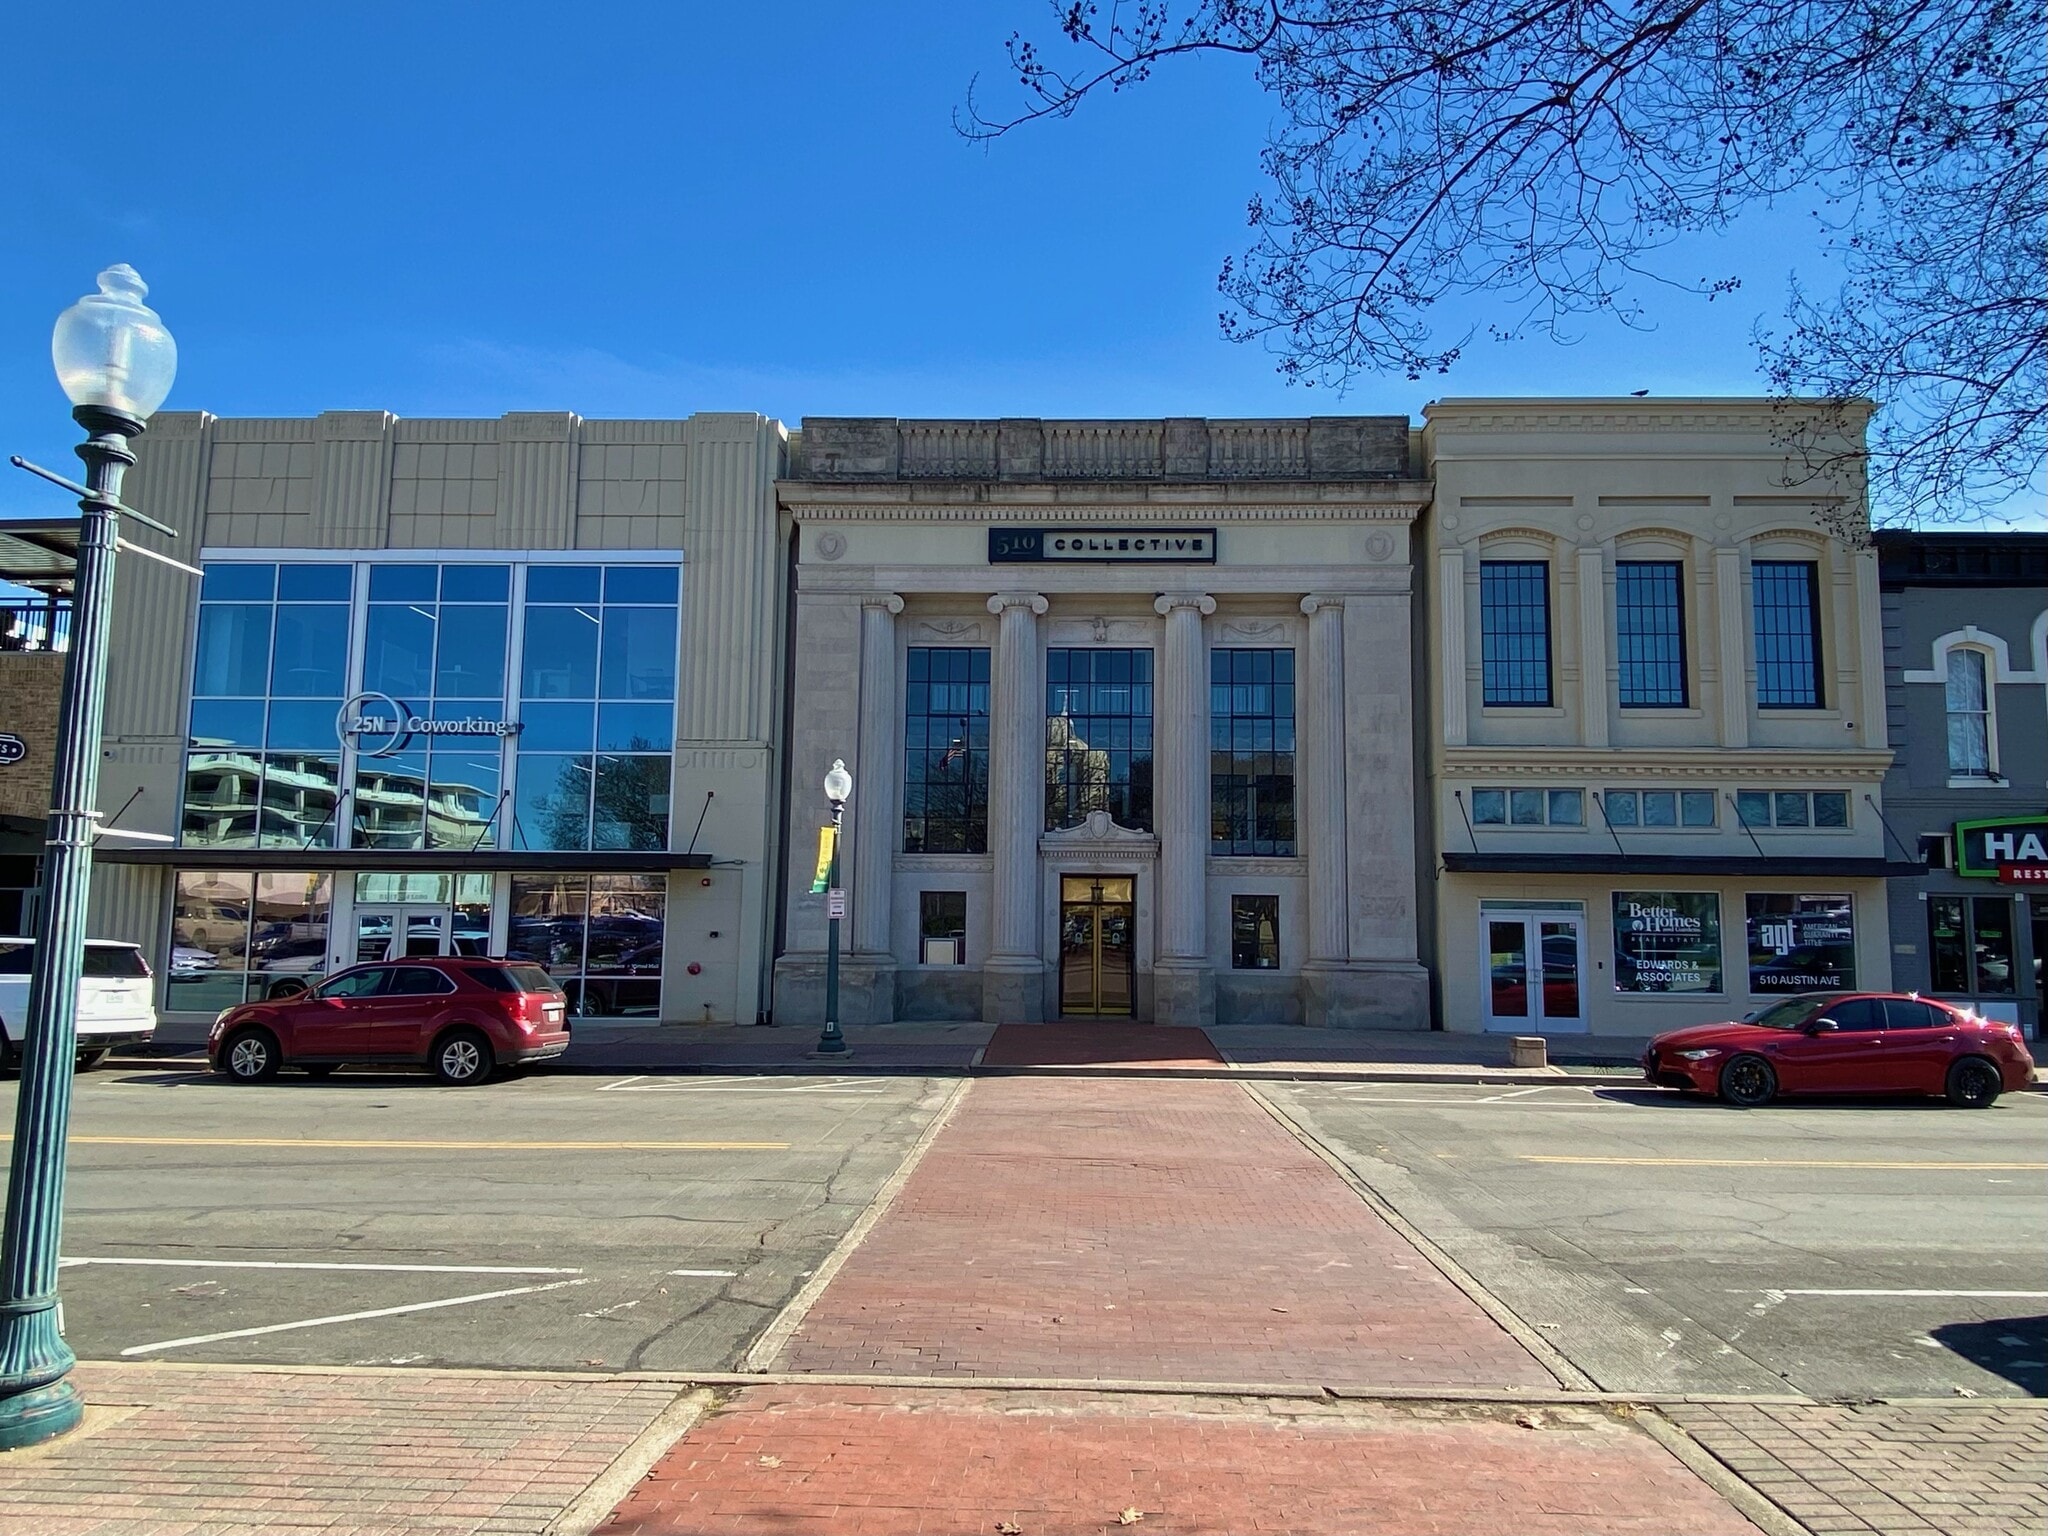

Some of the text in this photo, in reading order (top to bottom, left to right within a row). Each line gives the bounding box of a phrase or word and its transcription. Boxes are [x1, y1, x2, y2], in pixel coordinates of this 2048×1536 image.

[997, 536, 1204, 555] 510 COLLECTIVE
[352, 715, 509, 737] 25N Coworking
[1984, 832, 2048, 860] HA
[1629, 902, 1676, 918] Better
[1645, 917, 1701, 932] Homes
[1761, 919, 1797, 955] agt
[1804, 939, 1823, 947] TITLE
[1636, 960, 1699, 970] EDWARDS &
[1635, 972, 1701, 982] ASSOCIATES
[1759, 975, 1841, 985] 510 AUSTIN AVE
